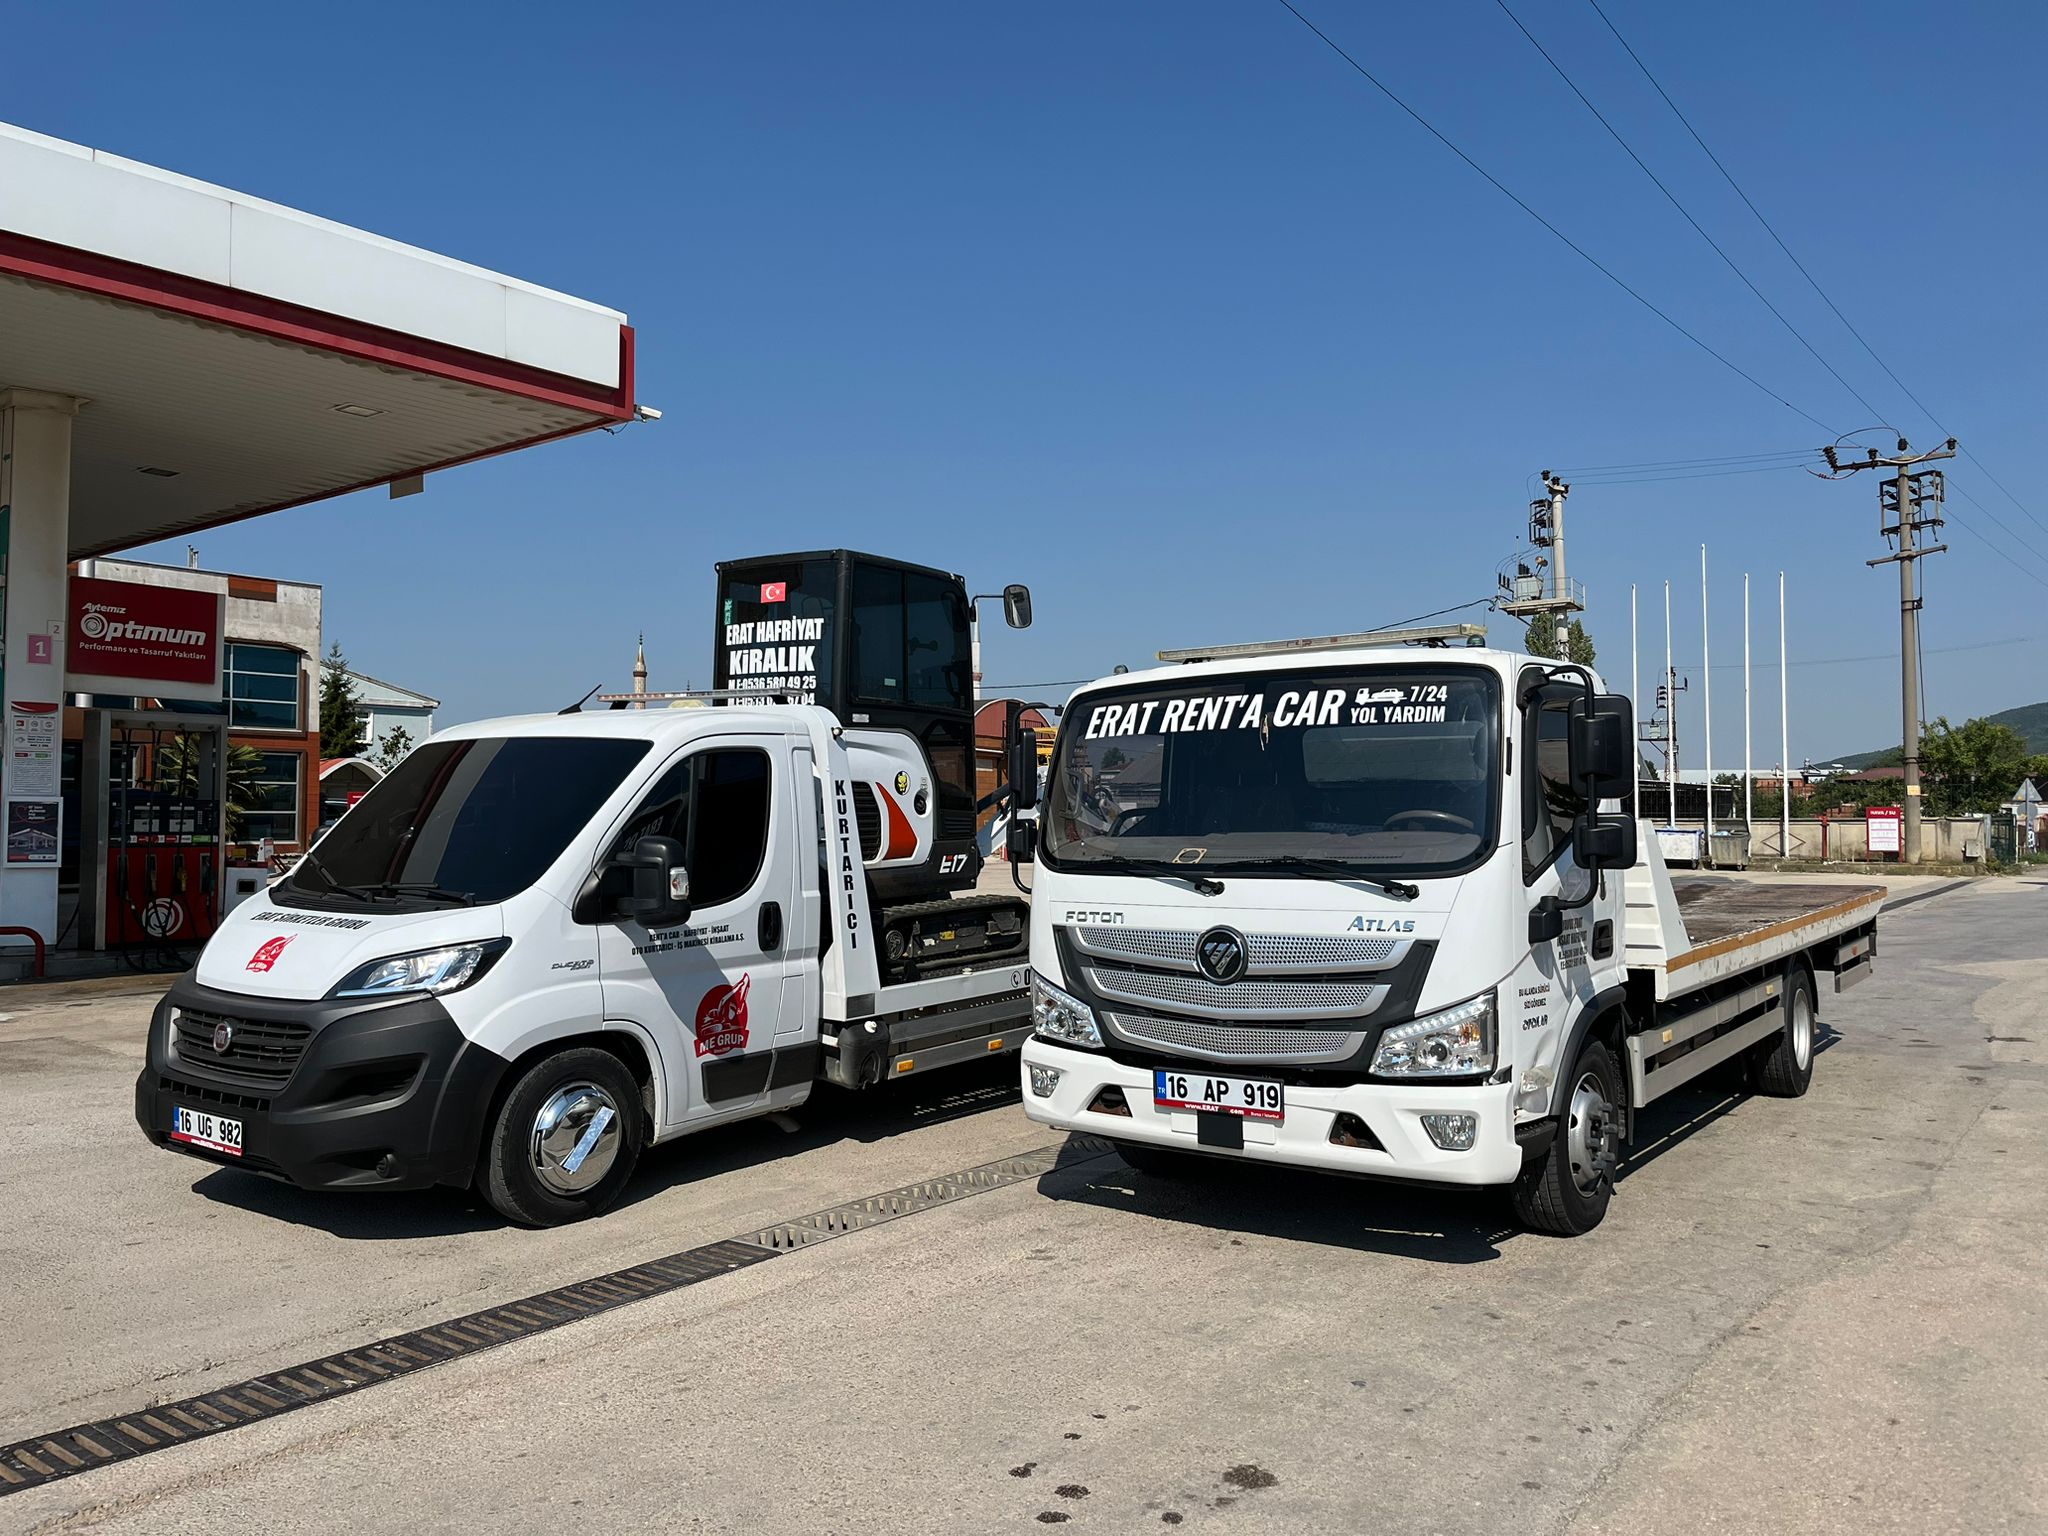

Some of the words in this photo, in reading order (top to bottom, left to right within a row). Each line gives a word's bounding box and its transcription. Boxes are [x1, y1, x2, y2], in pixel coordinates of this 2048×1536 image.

[53, 625, 60, 634] 2
[80, 612, 206, 646] Optimum
[726, 622, 755, 646] ERAT
[756, 615, 825, 643] HAFRİYAT
[35, 641, 47, 657] 1
[79, 641, 127, 654] Performans
[140, 647, 173, 657] Tasarruf
[174, 650, 206, 660] Yakıtları
[767, 676, 786, 690] 580
[787, 676, 801, 689] 49
[802, 675, 817, 689] 25
[801, 693, 815, 705] 04
[1410, 685, 1448, 702] 7/24
[1084, 701, 1159, 740] ERAT
[1159, 693, 1264, 734] RENT'A
[1272, 688, 1347, 728] CAR
[1350, 707, 1378, 724] YOL
[1383, 705, 1446, 723] YARDIM
[834, 780, 858, 950] KURTARICI
[939, 854, 968, 874] E17
[1065, 911, 1124, 924] FOTON
[700, 1037, 716, 1054] ME
[717, 1033, 744, 1046] GRUP
[1168, 1075, 1188, 1099] 16
[1203, 1079, 1230, 1103] AP
[1243, 1083, 1279, 1109] 919
[180, 1110, 192, 1133] 16
[198, 1114, 212, 1138] UG
[220, 1120, 241, 1146] 982
